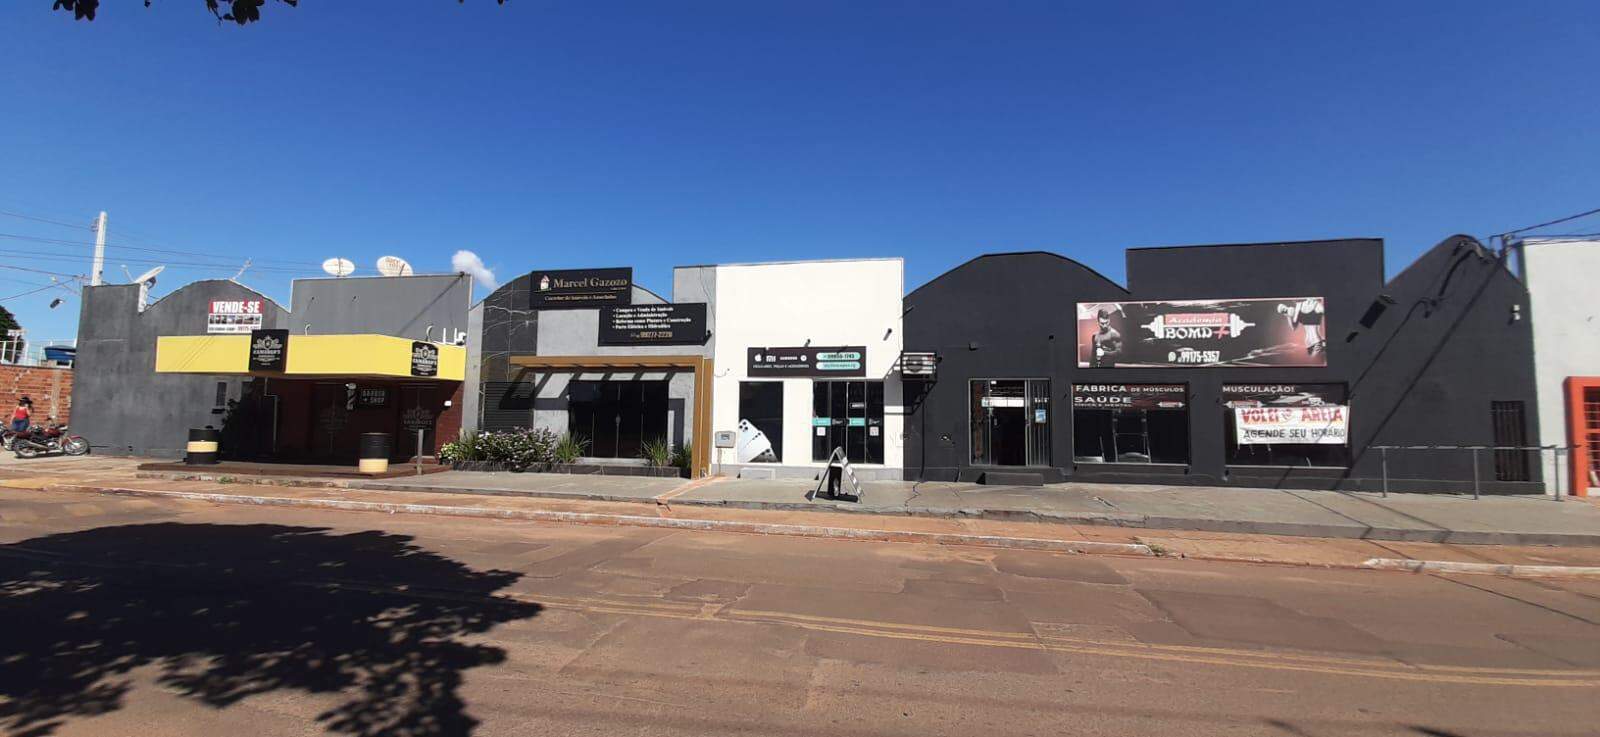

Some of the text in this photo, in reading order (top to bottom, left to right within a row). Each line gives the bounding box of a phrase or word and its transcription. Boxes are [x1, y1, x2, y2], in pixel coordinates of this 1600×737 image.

[553, 277, 627, 288] Marcel Gazozo
[212, 301, 260, 313] VENDE-SE
[1222, 385, 1295, 394] MUSCULAÇÃO!
[1243, 429, 1285, 439] AGENDE
[1289, 428, 1307, 438] SEU
